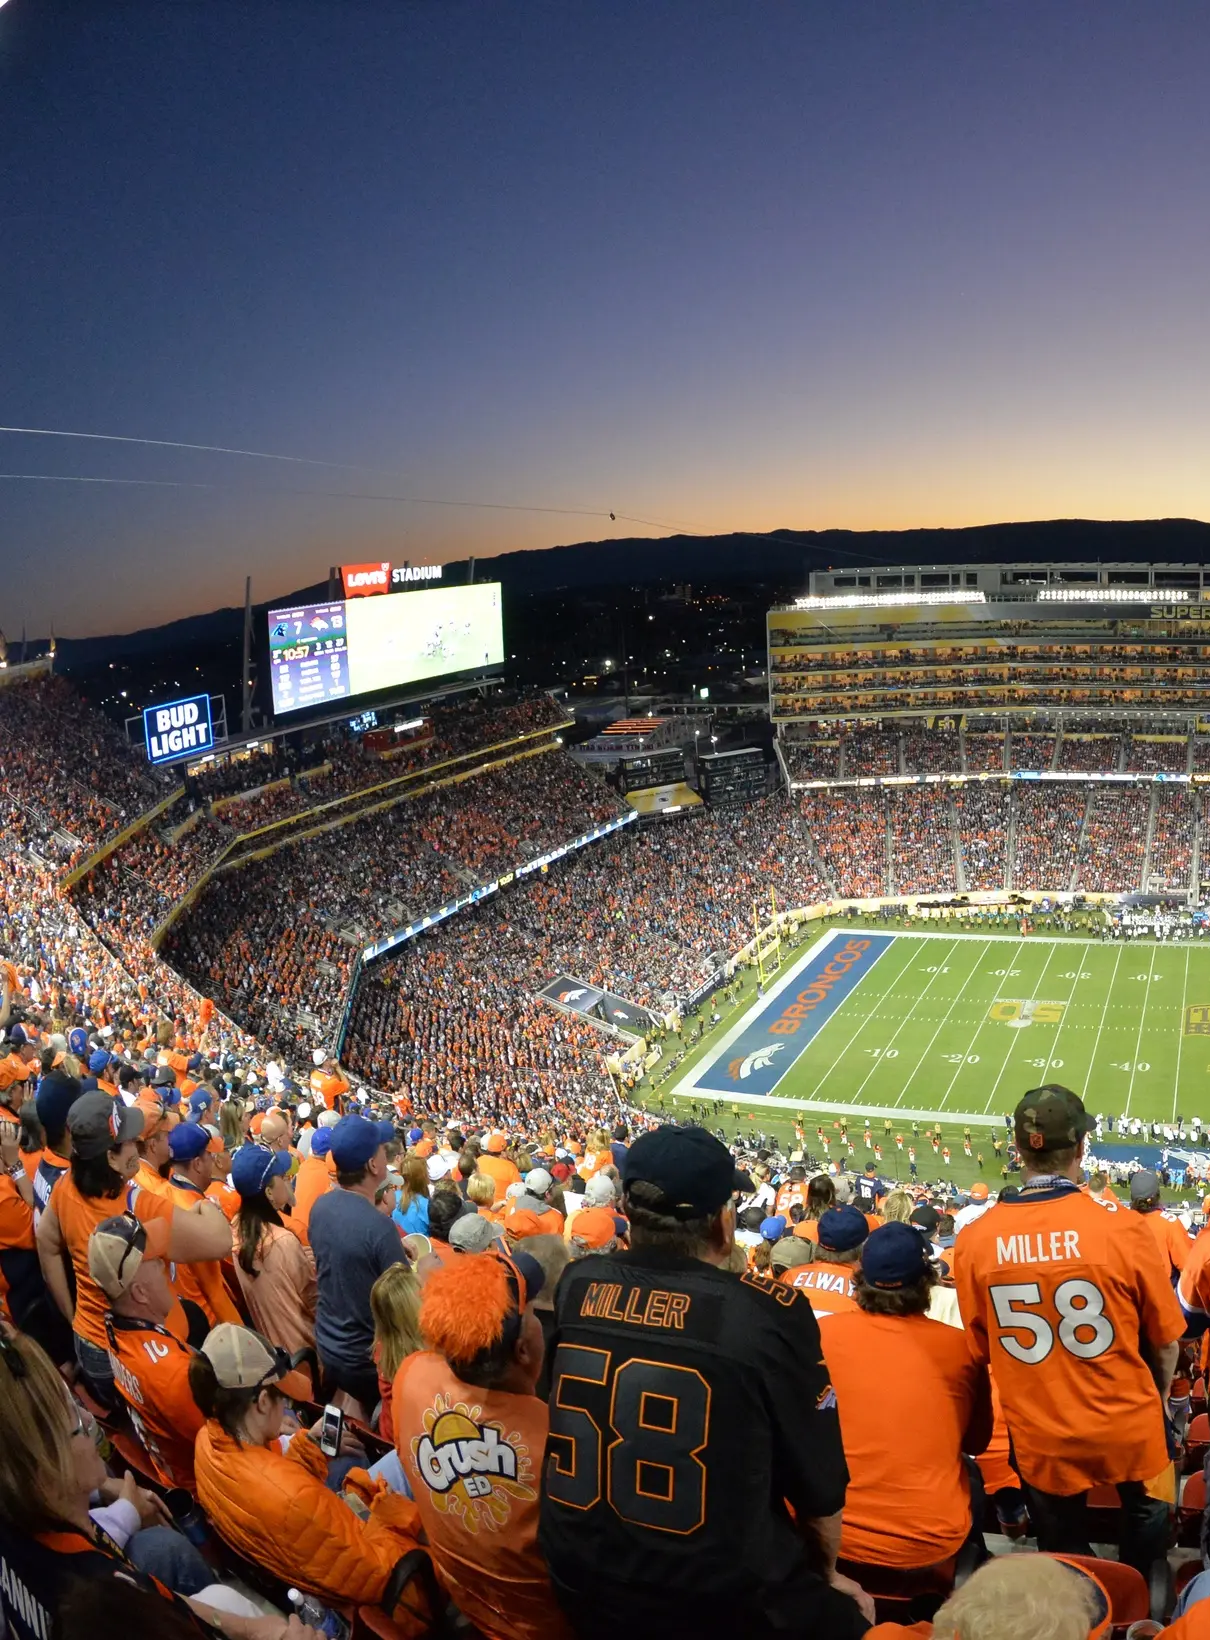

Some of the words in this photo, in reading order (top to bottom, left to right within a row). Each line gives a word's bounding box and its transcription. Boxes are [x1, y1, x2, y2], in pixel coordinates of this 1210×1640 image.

[392, 565, 442, 583] STADIUM
[282, 645, 310, 661] 10:57
[156, 702, 199, 733] BUD
[149, 722, 208, 758] LIGHT
[768, 938, 872, 1035] BRONCOS
[871, 1047, 900, 1059] 10
[949, 1053, 981, 1065] 20
[1030, 1057, 1065, 1070] 30
[1118, 1060, 1151, 1073] 40
[996, 1230, 1081, 1265] MILLER
[793, 1271, 856, 1297] ELWAY
[580, 1283, 691, 1330] MILLER
[988, 1278, 1115, 1365] 58
[547, 1343, 712, 1535] 58
[462, 1475, 493, 1499] ED
